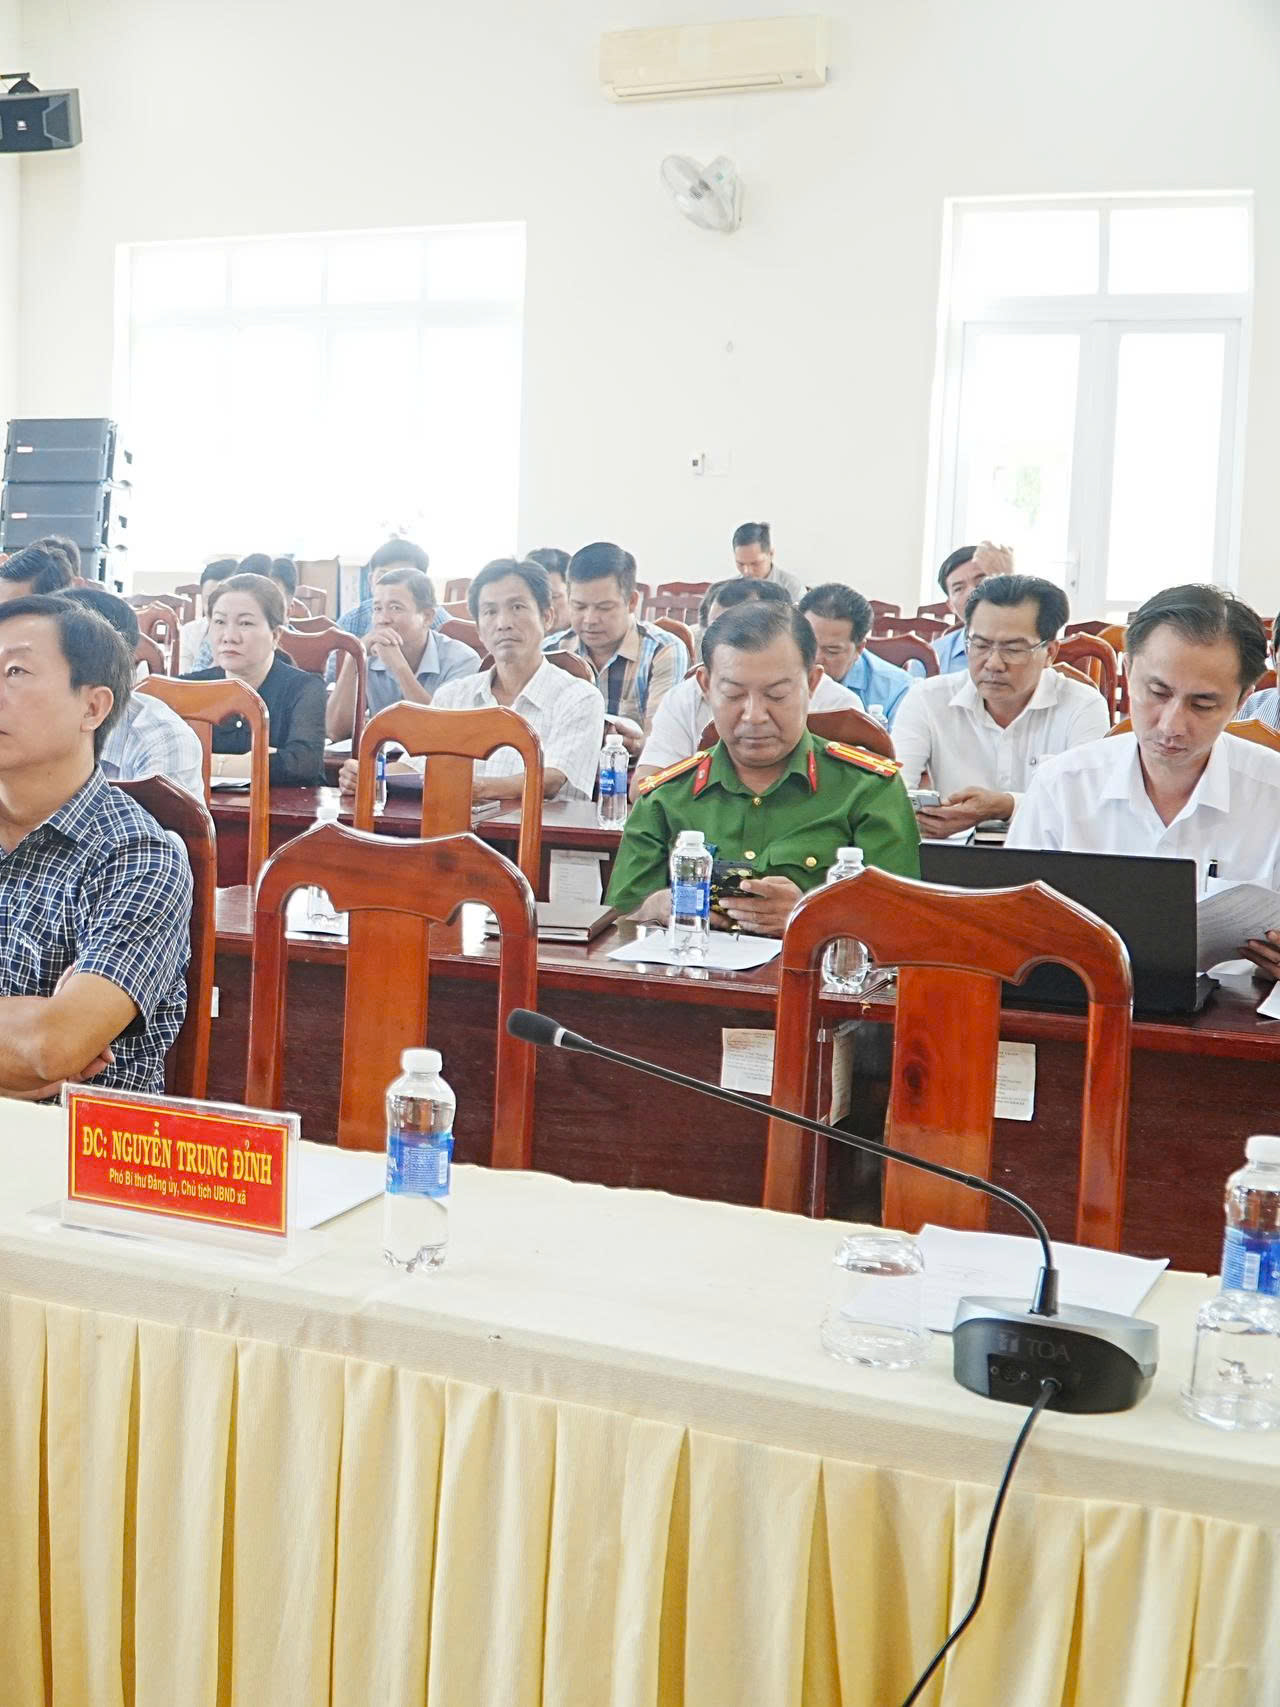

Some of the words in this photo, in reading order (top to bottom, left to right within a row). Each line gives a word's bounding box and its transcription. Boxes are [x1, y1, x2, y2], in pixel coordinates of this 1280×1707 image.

[82, 1126, 107, 1159] ĐC:
[112, 1120, 172, 1168] NGUYỄN
[177, 1141, 229, 1178] TRUNG
[233, 1139, 273, 1185] ĐỈNH
[109, 1168, 123, 1185] Phó
[125, 1171, 133, 1185] Bí
[134, 1174, 147, 1189] thư
[147, 1173, 166, 1195] Đảng
[181, 1179, 196, 1196] Chủ
[198, 1183, 212, 1200] tịch
[214, 1185, 236, 1203] UBND
[237, 1189, 247, 1205] xã
